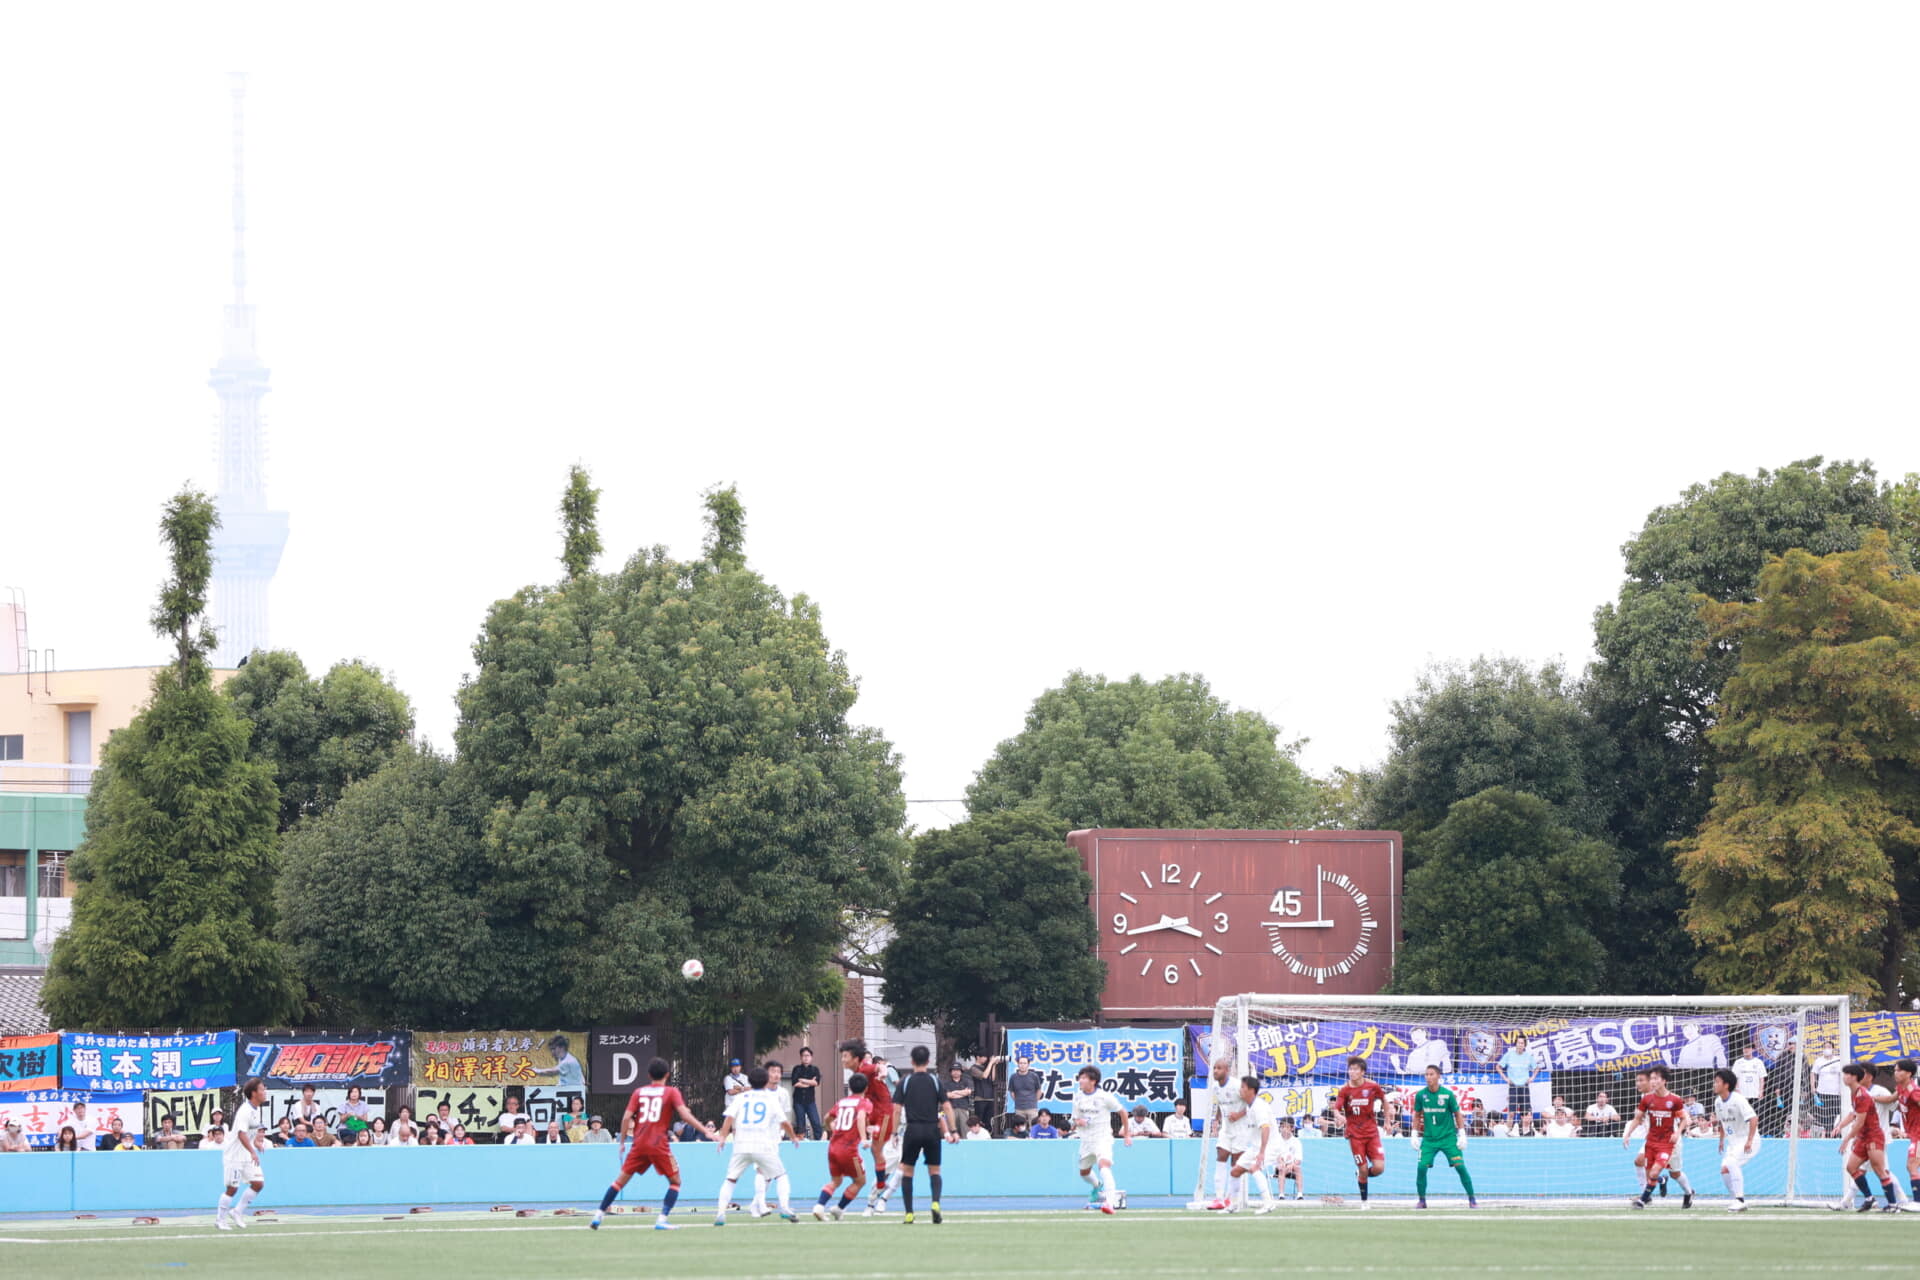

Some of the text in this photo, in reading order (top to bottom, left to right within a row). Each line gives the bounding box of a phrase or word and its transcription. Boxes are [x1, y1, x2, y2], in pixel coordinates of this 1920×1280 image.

[1161, 863, 1182, 884] 12
[1269, 890, 1302, 917] 45
[1112, 913, 1128, 934] 9
[1213, 912, 1229, 934] 3
[1164, 964, 1179, 984] 6
[599, 1034, 651, 1045] 芝生スタンド
[72, 1048, 221, 1078] 稲本潤一
[424, 1055, 537, 1083] 相澤祥太
[612, 1052, 639, 1086] D
[1016, 1068, 1178, 1101] たの本気
[638, 1096, 663, 1123] 39
[742, 1101, 767, 1124] 19
[835, 1107, 855, 1131] 10
